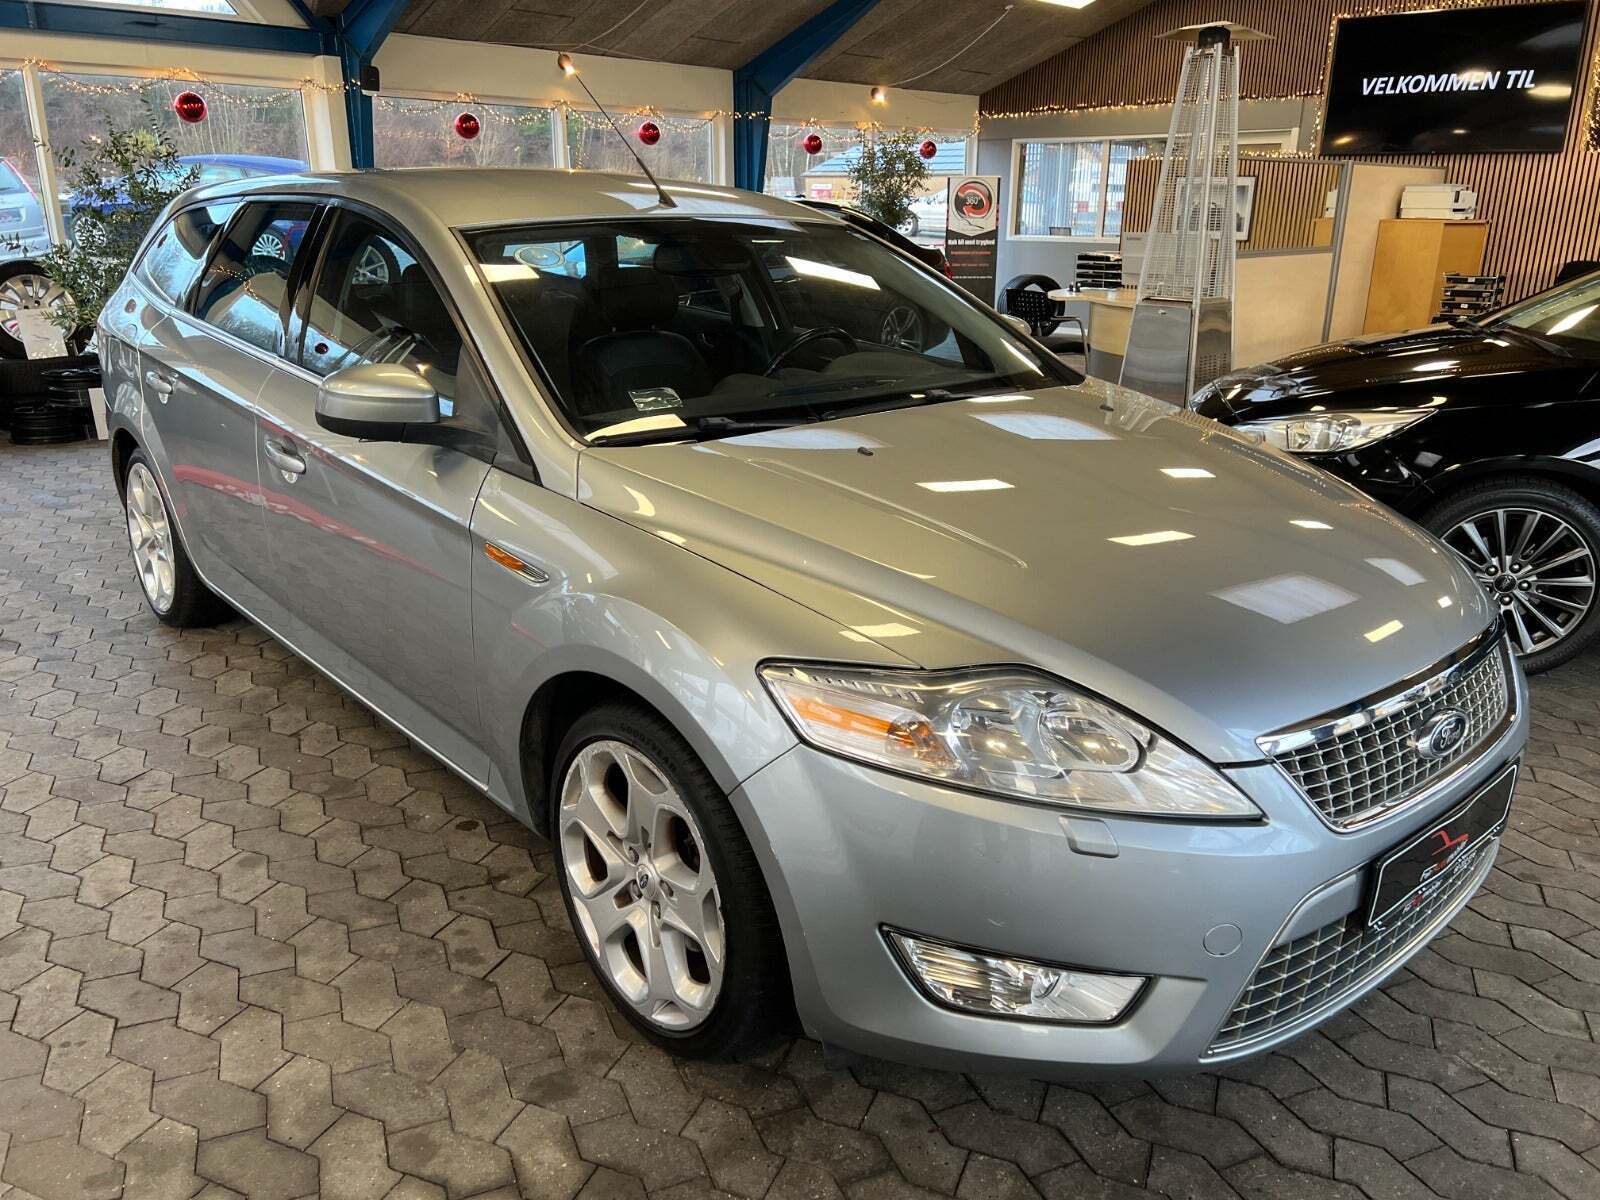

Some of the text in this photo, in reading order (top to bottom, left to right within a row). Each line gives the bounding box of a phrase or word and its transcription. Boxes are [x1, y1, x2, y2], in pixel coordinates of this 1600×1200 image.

[1362, 69, 1536, 95] VELKOMMEN TIL
[1440, 721, 1462, 749] Ford
